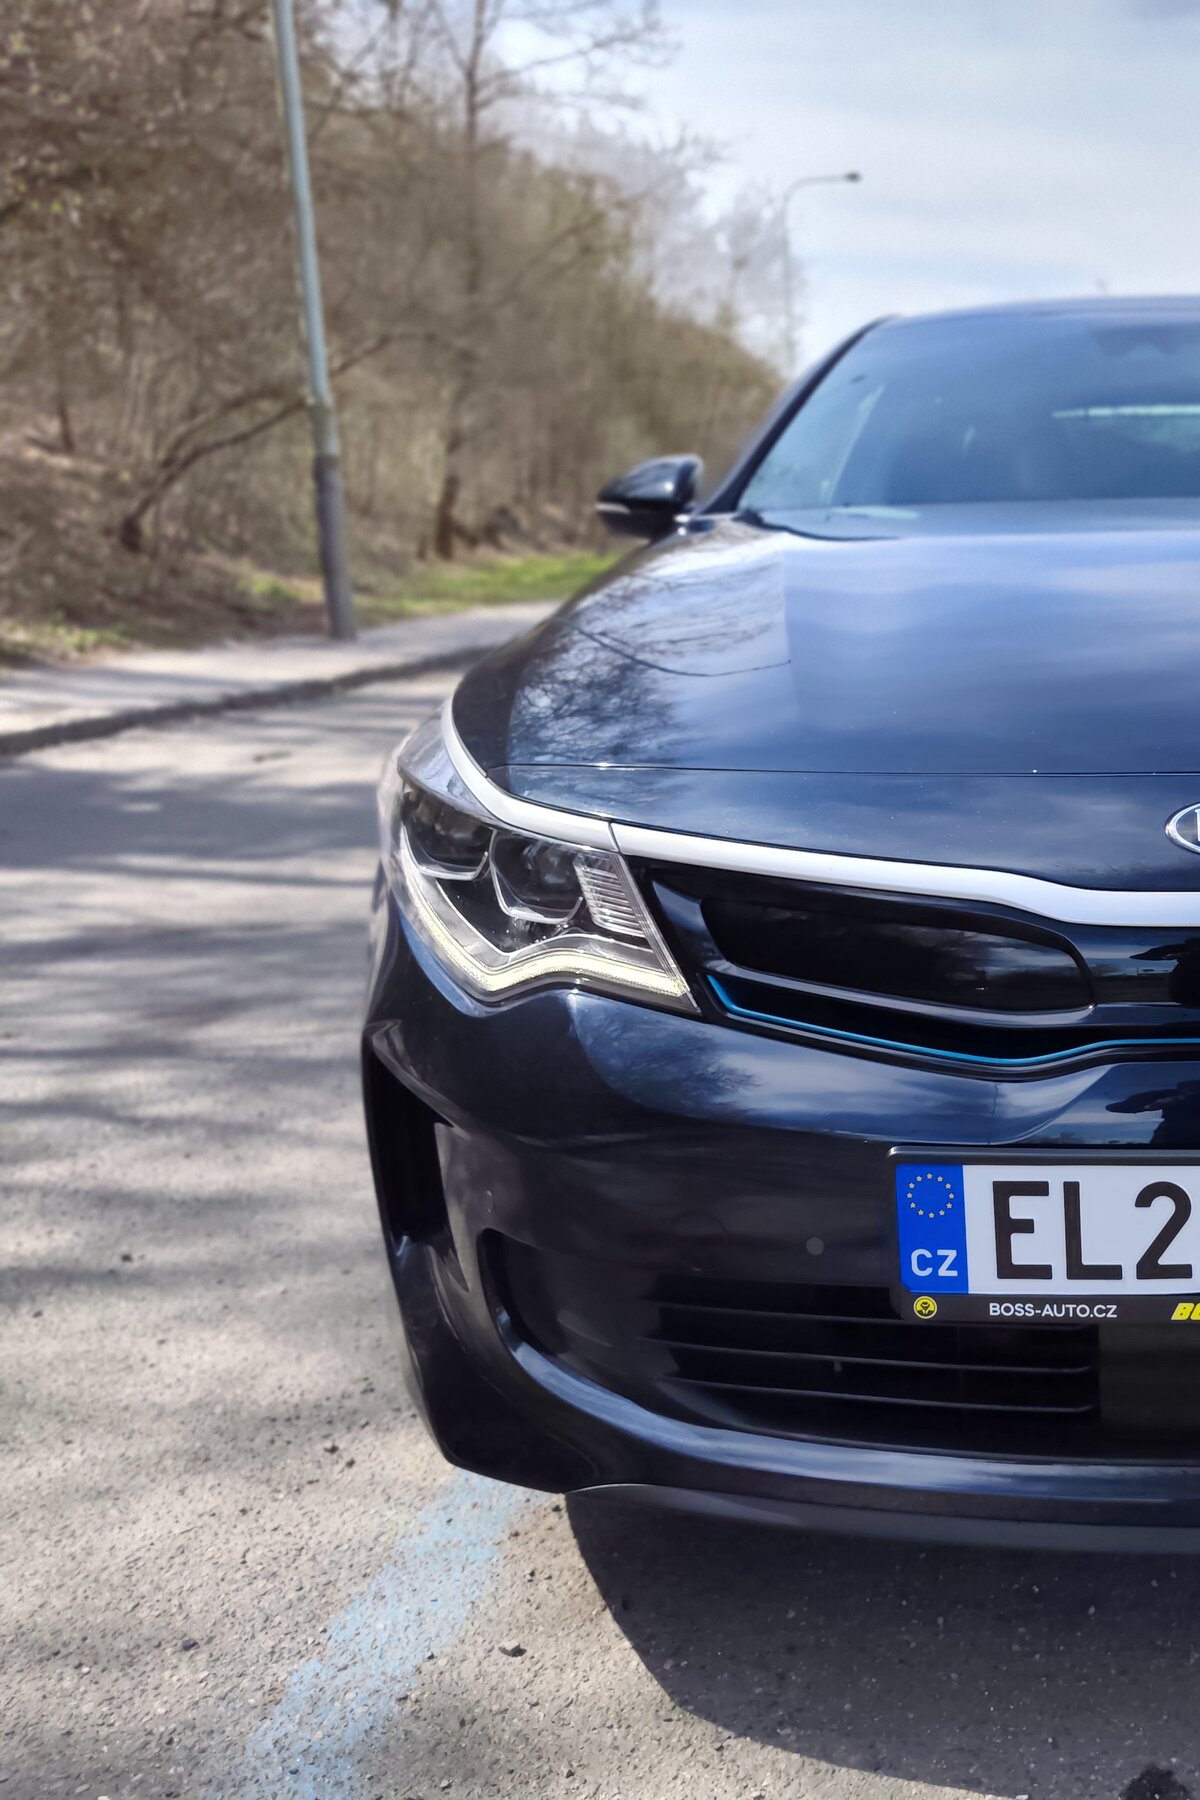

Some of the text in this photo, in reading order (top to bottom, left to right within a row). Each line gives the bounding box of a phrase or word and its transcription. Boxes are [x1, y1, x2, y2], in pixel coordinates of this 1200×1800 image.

[991, 1180, 1194, 1281] EL2
[910, 1248, 959, 1277] CZ
[989, 1302, 1118, 1319] BOSS-AUTO.CZ
